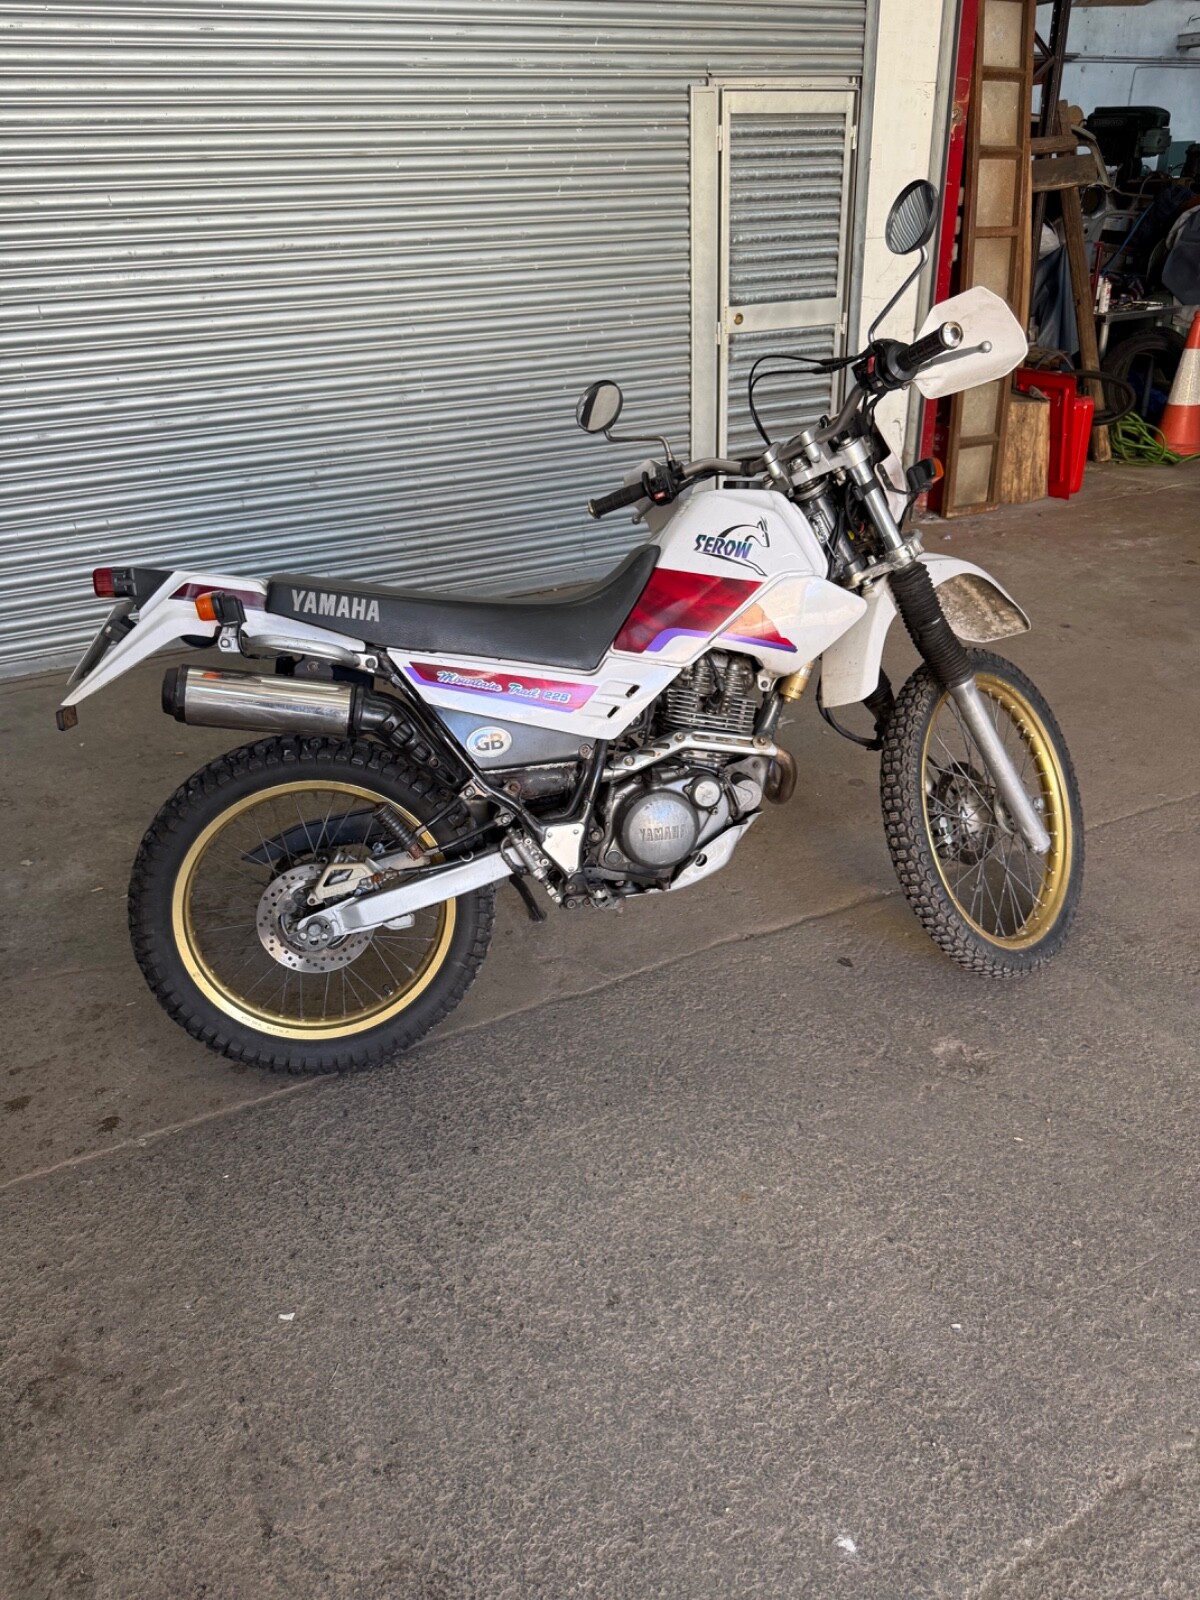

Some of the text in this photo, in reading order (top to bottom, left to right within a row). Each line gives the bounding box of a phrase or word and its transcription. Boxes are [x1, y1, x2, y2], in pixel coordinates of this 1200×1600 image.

[694, 534, 753, 559] SEROW
[292, 589, 380, 622] YAMAHA
[437, 671, 570, 703] Mountain Trail 225
[476, 733, 504, 750] GB
[640, 824, 689, 841] YAMAHA
